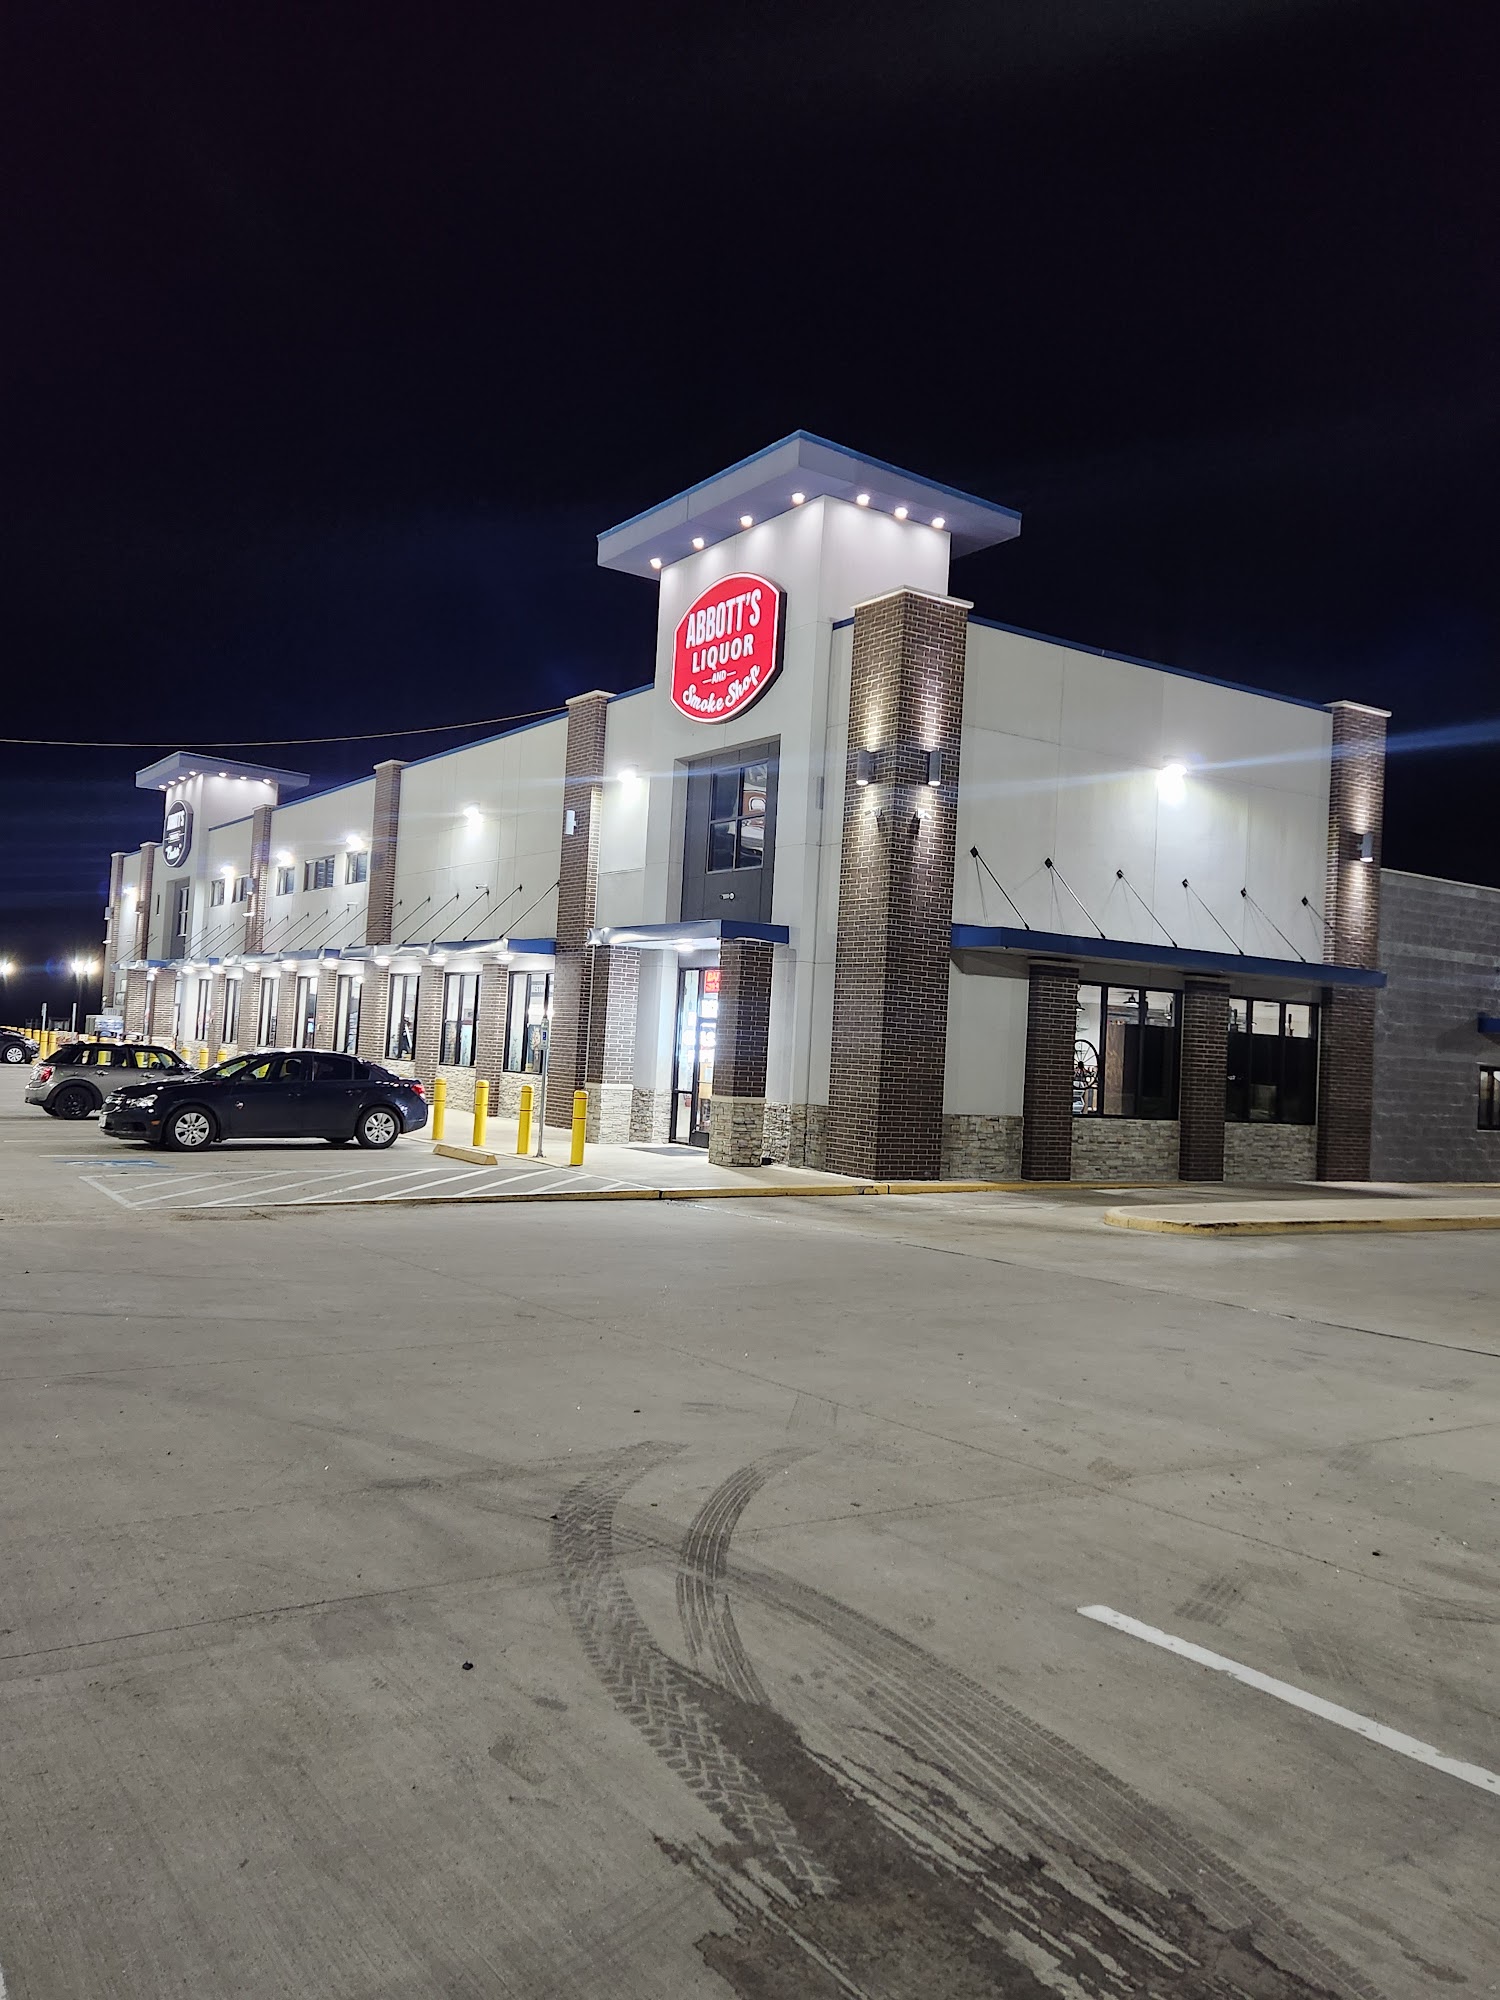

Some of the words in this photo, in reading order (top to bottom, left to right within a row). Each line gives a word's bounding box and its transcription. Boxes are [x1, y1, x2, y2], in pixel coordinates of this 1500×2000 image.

[686, 588, 762, 649] ABBOTT'S
[692, 633, 755, 674] LIQUOR
[682, 684, 724, 713] Smoke
[725, 664, 761, 707] Shop
[711, 669, 727, 684] AND
